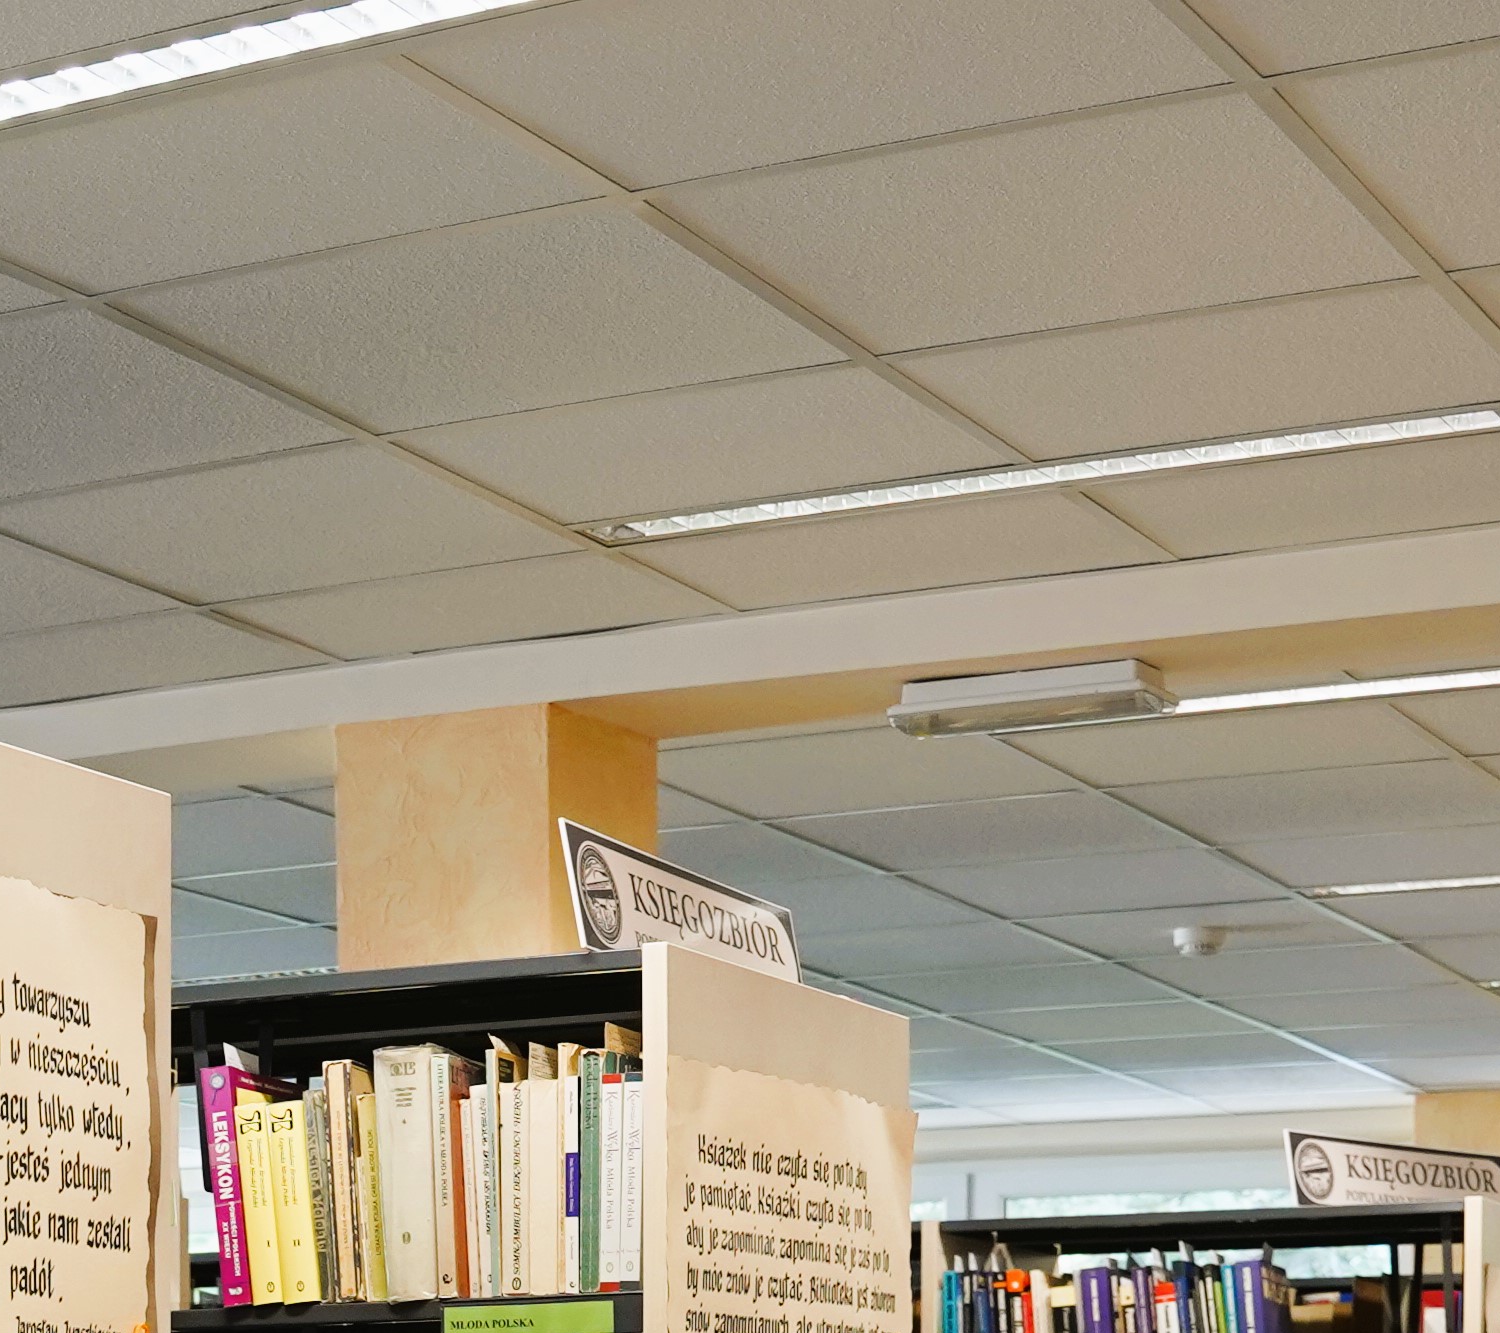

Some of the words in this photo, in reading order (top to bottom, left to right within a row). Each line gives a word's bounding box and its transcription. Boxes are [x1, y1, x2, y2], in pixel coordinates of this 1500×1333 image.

[628, 872, 785, 965] KSIĘGOZBIÓR
[12, 974, 90, 1033] towarzyszu
[10, 1037, 20, 1063] w
[38, 1097, 74, 1138] tylko
[59, 1151, 112, 1201] jednym
[212, 1111, 234, 1201] LEKSYKON
[698, 1134, 746, 1173] Książek
[753, 1143, 771, 1173] nie
[777, 1151, 808, 1188] czyta
[813, 1152, 829, 1185] się
[1345, 1154, 1498, 1194] KSIĘGOZBIÓR
[2, 1198, 41, 1245] jakie
[48, 1212, 79, 1246] nam
[605, 1200, 615, 1229] Polska
[626, 1198, 635, 1228] Polska
[683, 1174, 695, 1212] je
[758, 1185, 800, 1224] Książki
[806, 1200, 834, 1230] czyta
[838, 1201, 850, 1232] się
[687, 1219, 704, 1256] aby
[708, 1220, 718, 1256] je
[780, 1234, 831, 1267] zapomina
[835, 1237, 847, 1268] się
[687, 1262, 698, 1296] by
[702, 1262, 722, 1293] móc
[726, 1266, 750, 1294] znów
[752, 1268, 763, 1303] je
[492, 1318, 534, 1328] POLSKA
[686, 1303, 709, 1332] snów
